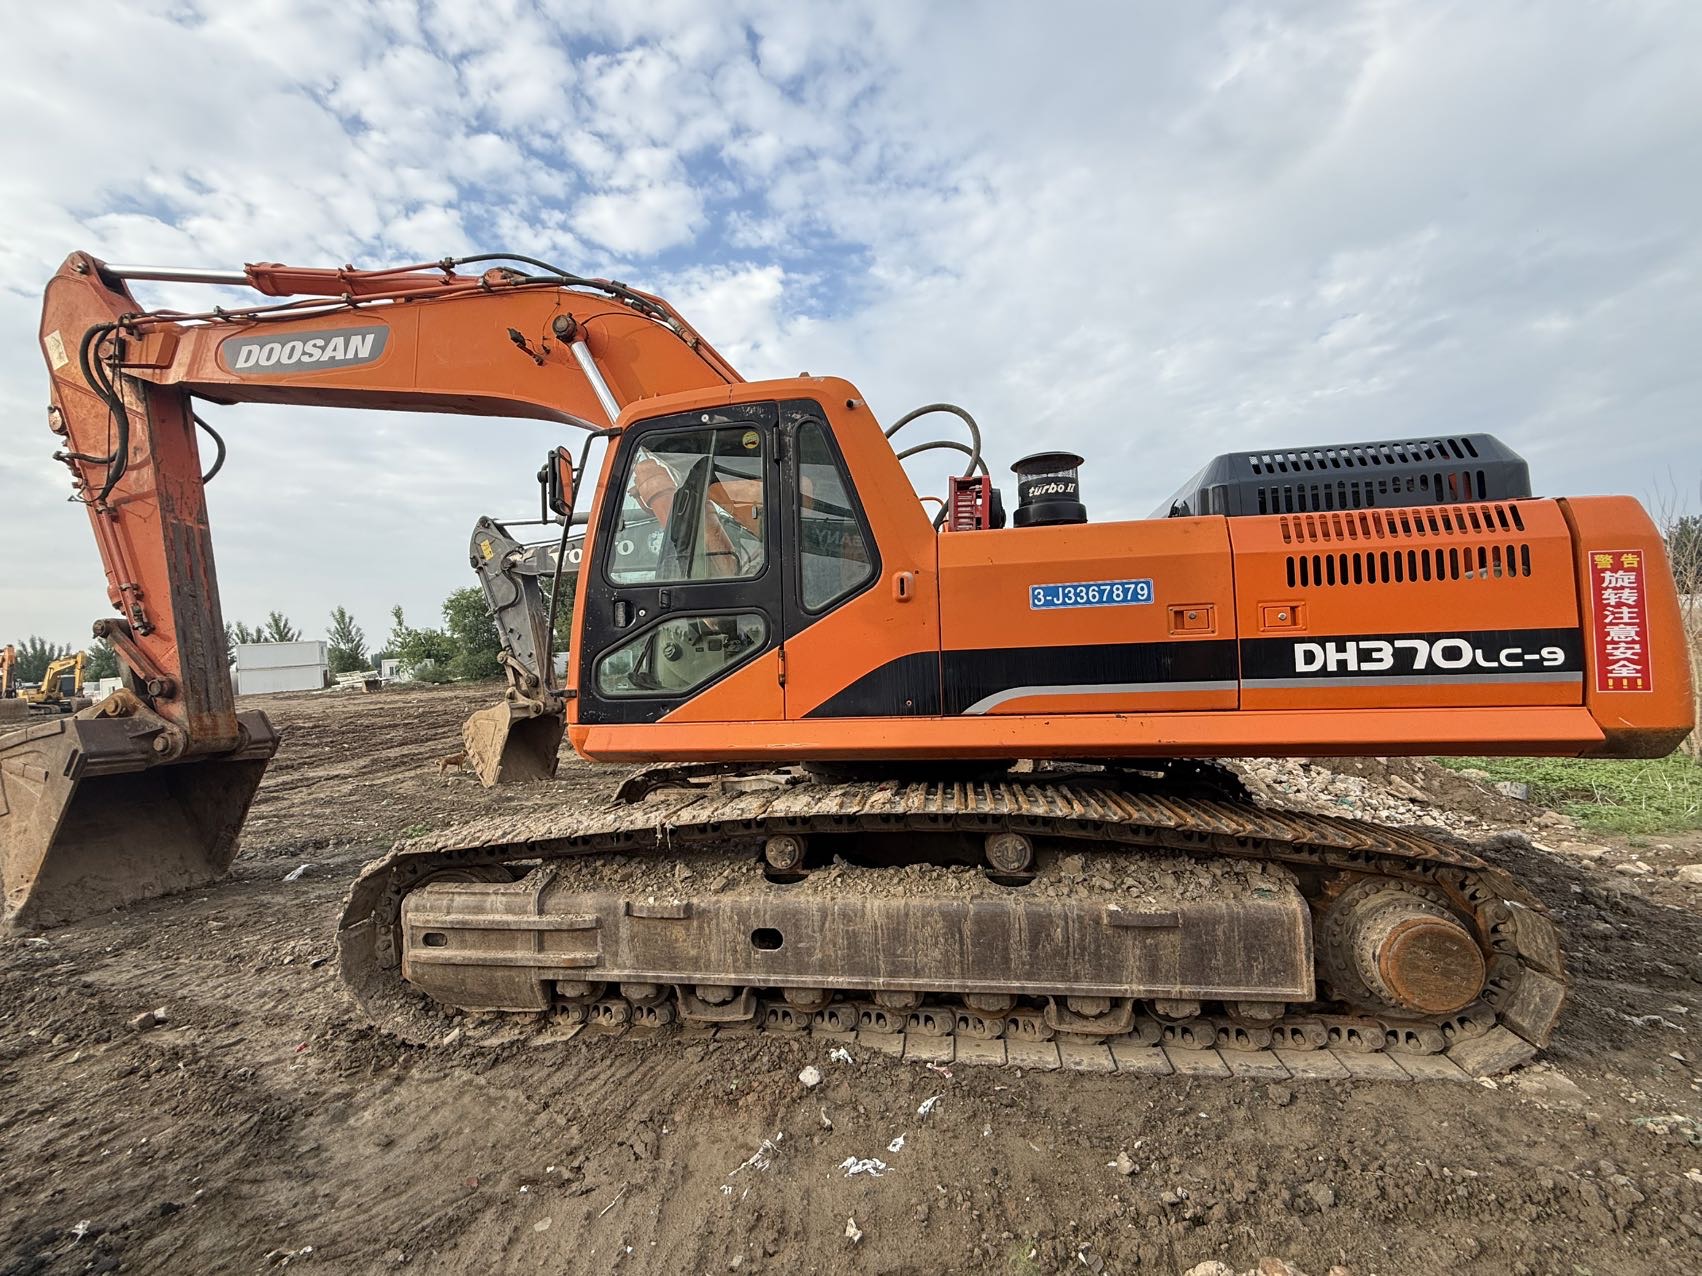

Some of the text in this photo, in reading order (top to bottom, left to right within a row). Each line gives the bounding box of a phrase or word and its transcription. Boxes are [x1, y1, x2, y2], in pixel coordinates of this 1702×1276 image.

[235, 333, 375, 368] DOOSAN
[1028, 482, 1065, 497] turbo
[1594, 553, 1640, 569] 警告
[1034, 583, 1148, 605] 3-J3367879
[1600, 570, 1643, 677] 旋转注意安全
